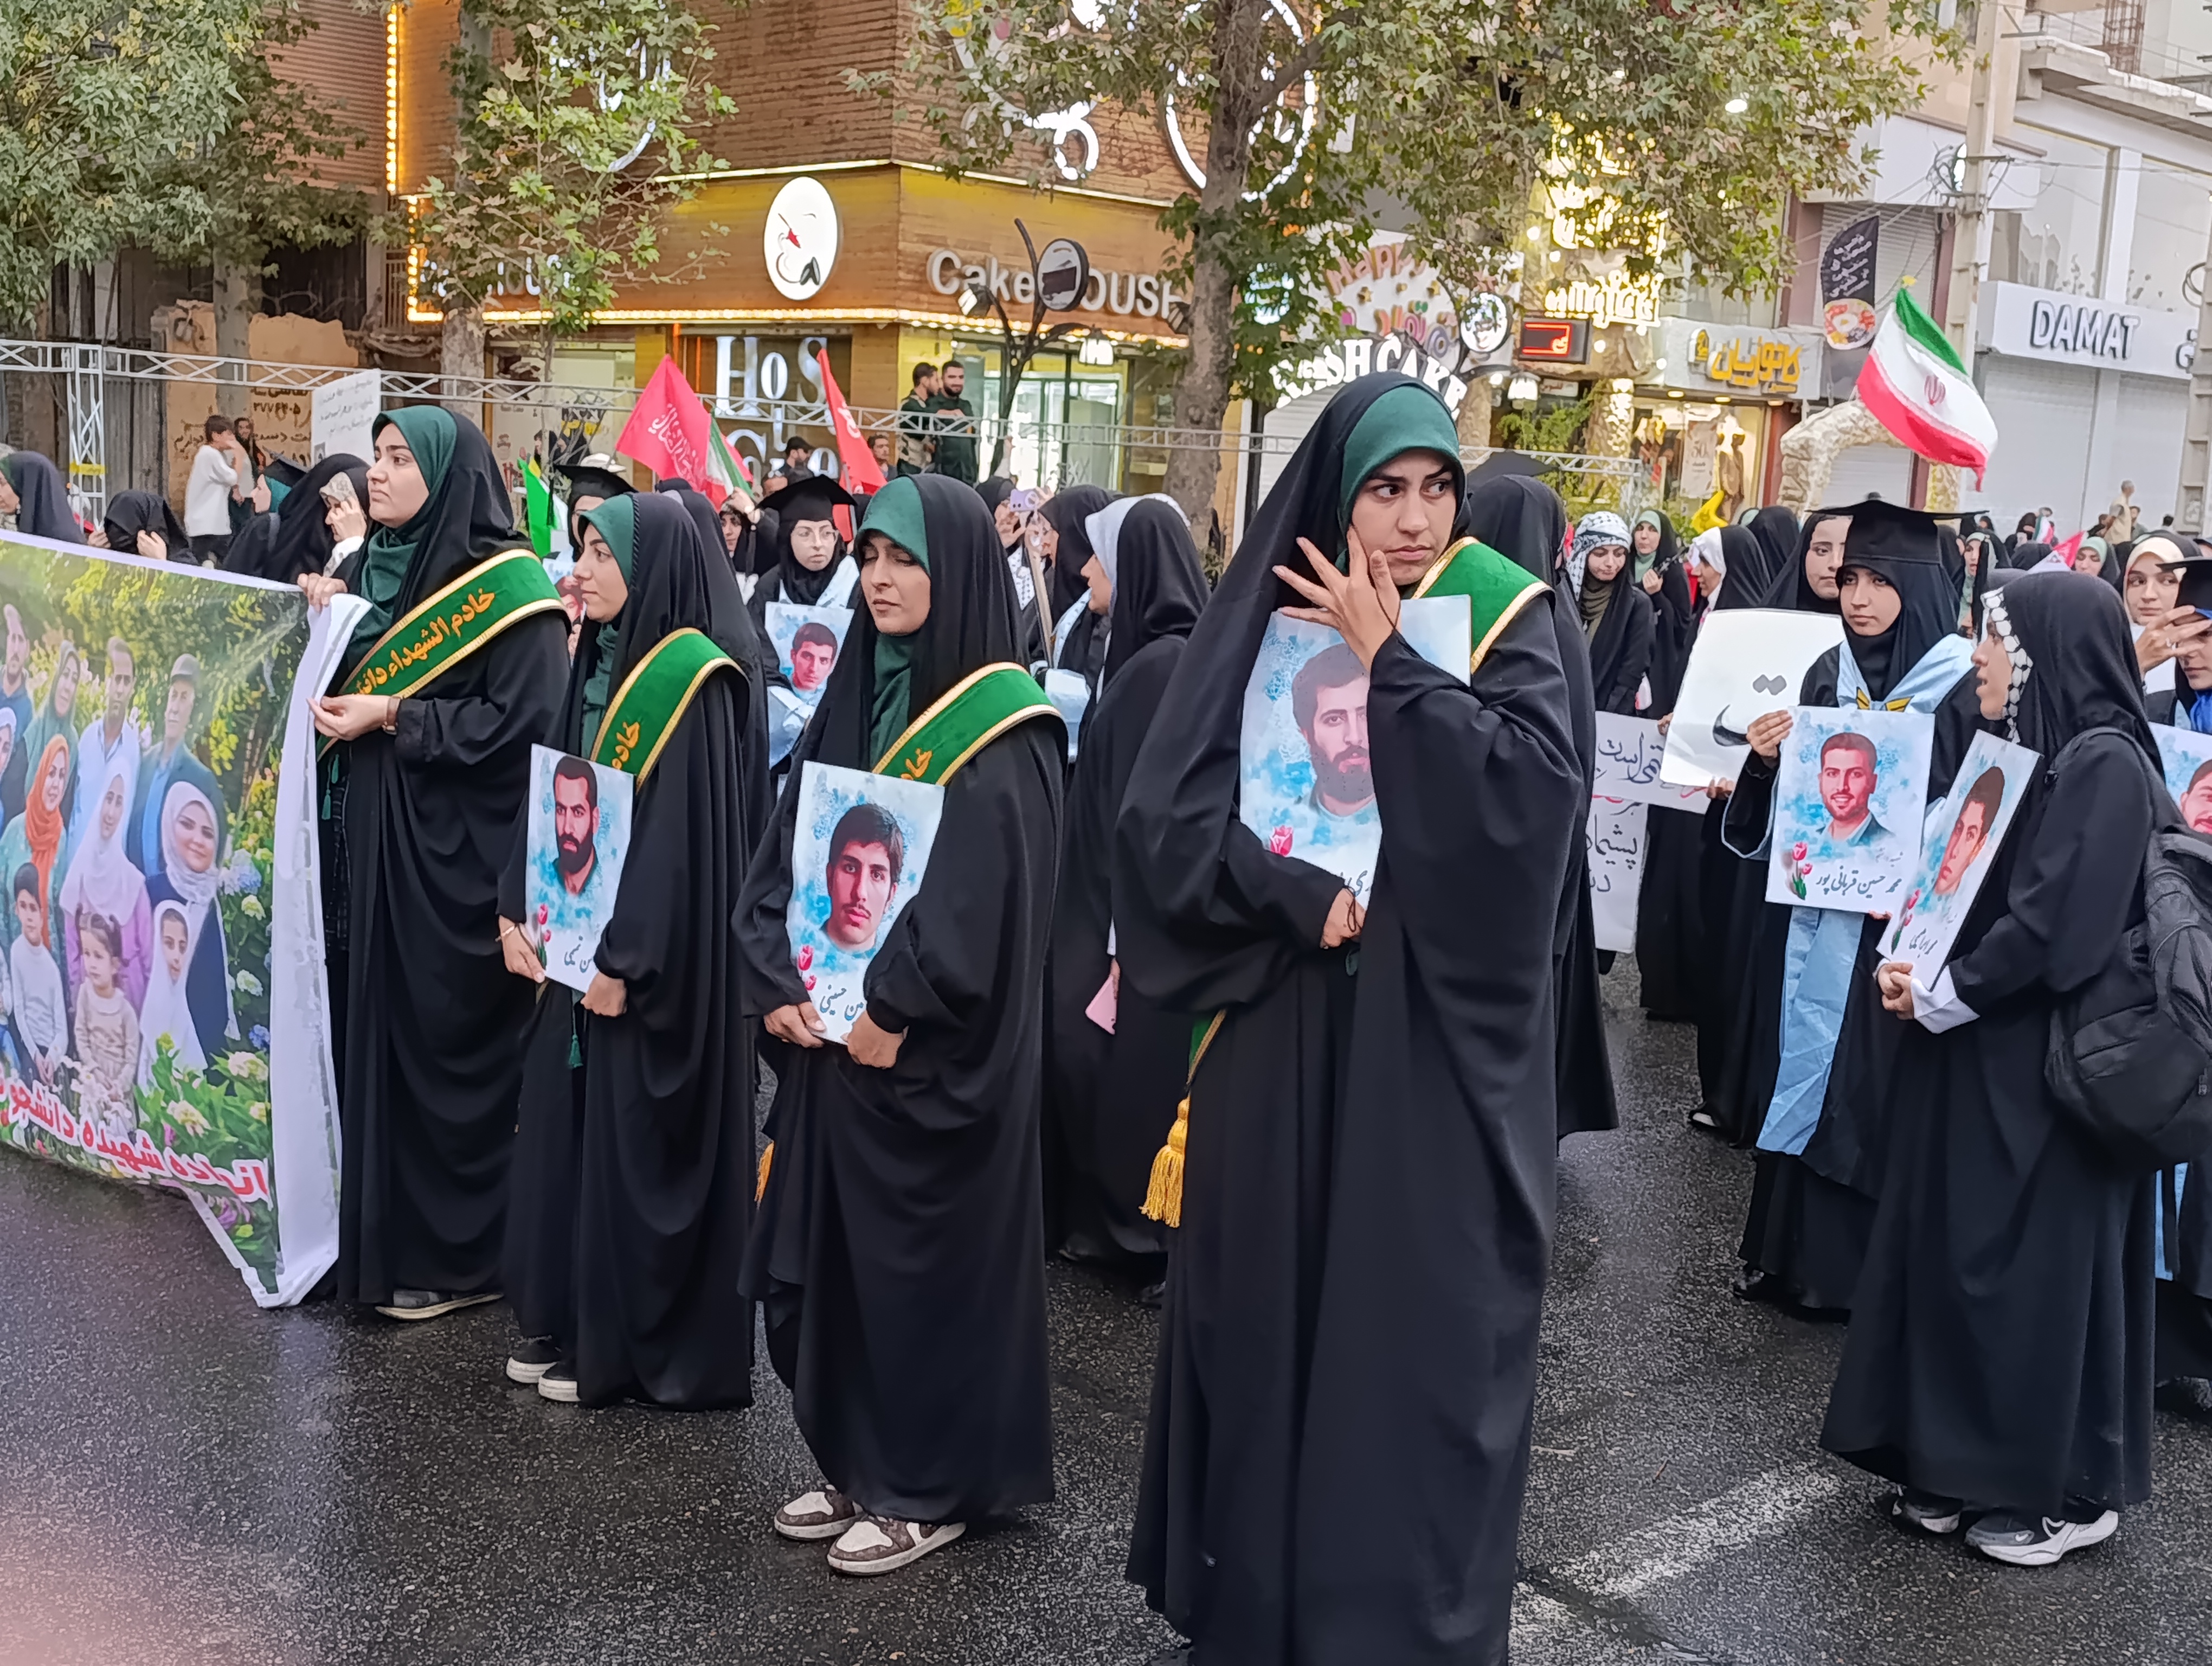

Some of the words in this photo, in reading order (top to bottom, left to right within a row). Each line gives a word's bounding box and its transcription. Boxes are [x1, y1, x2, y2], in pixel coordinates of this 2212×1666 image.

[928, 248, 1034, 303] Cake
[2030, 299, 2141, 360] DAMAT
[451, 588, 495, 637] خادم
[389, 616, 450, 678] الشهداء
[1816, 874, 1830, 895] پور
[1831, 865, 1859, 896] قربانی
[1857, 875, 1886, 898] حسین
[1885, 878, 1902, 893] محمد
[820, 984, 847, 1015] حسینی
[82, 1120, 163, 1172] شهیده
